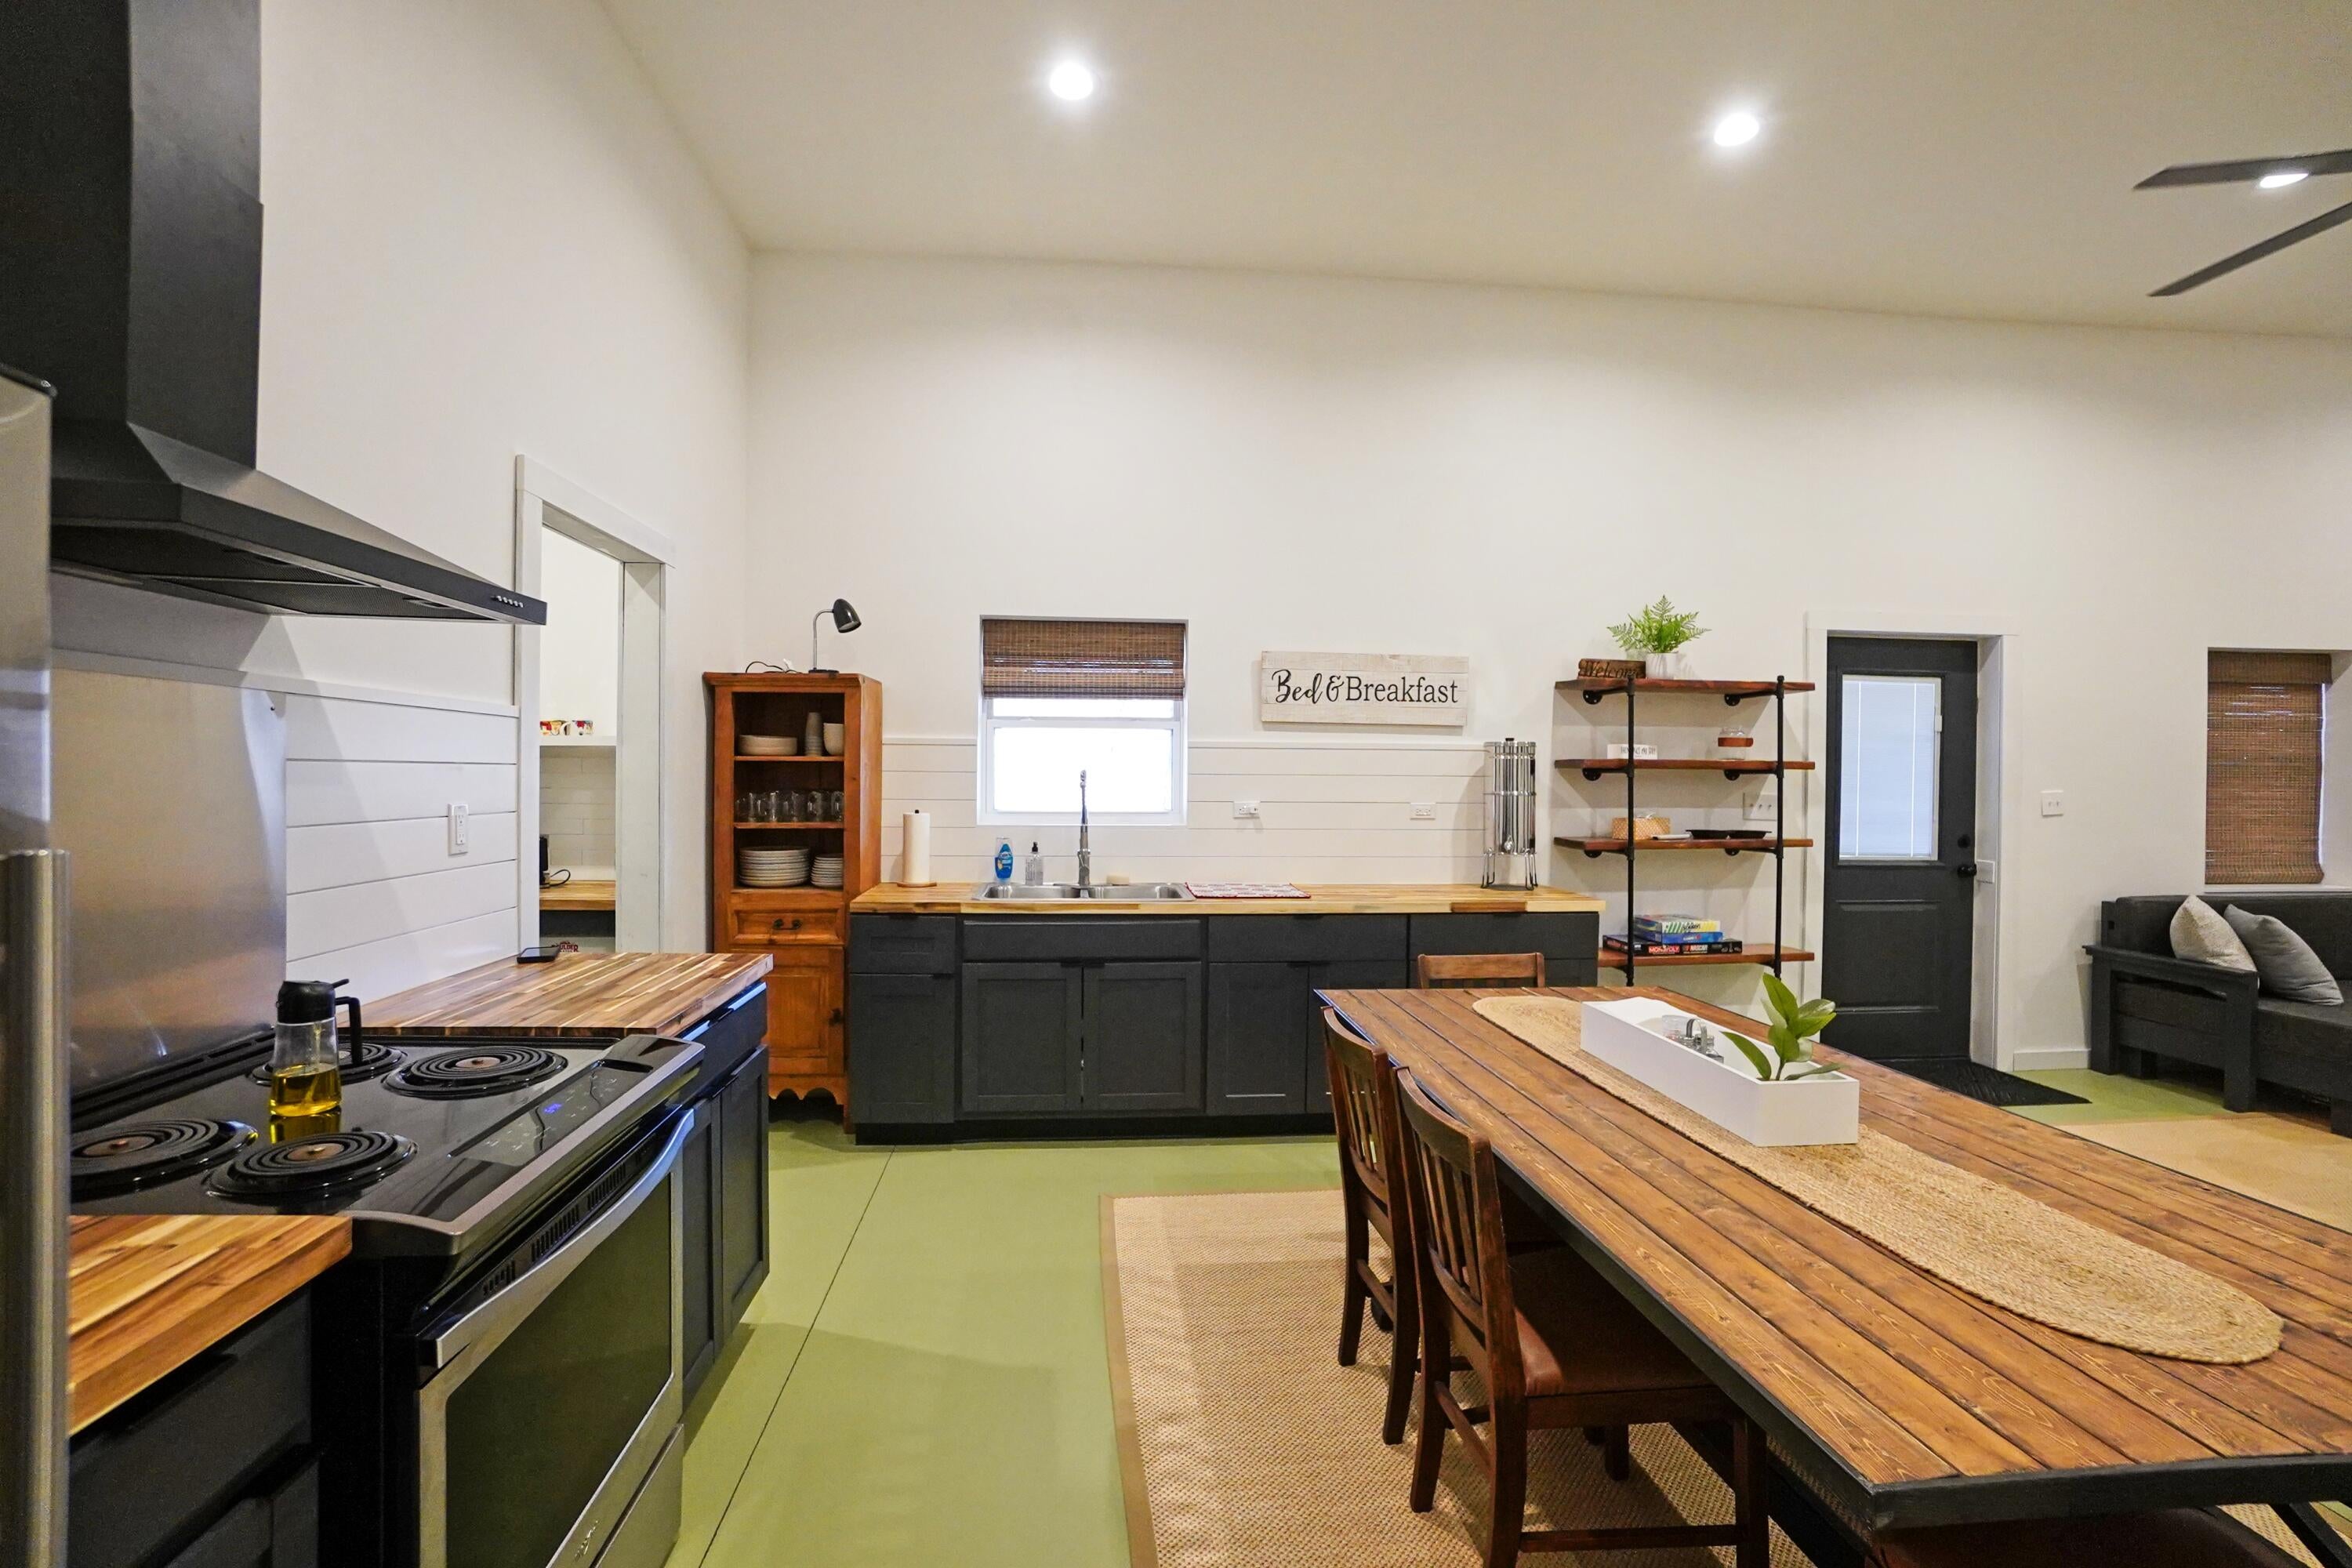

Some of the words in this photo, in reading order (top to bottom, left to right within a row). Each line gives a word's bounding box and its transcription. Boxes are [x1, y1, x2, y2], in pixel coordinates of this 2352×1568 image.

[1584, 661, 1639, 678] Welcom
[1272, 670, 1323, 703] Bed
[1327, 676, 1344, 702] &
[1346, 677, 1458, 703] Breakfast
